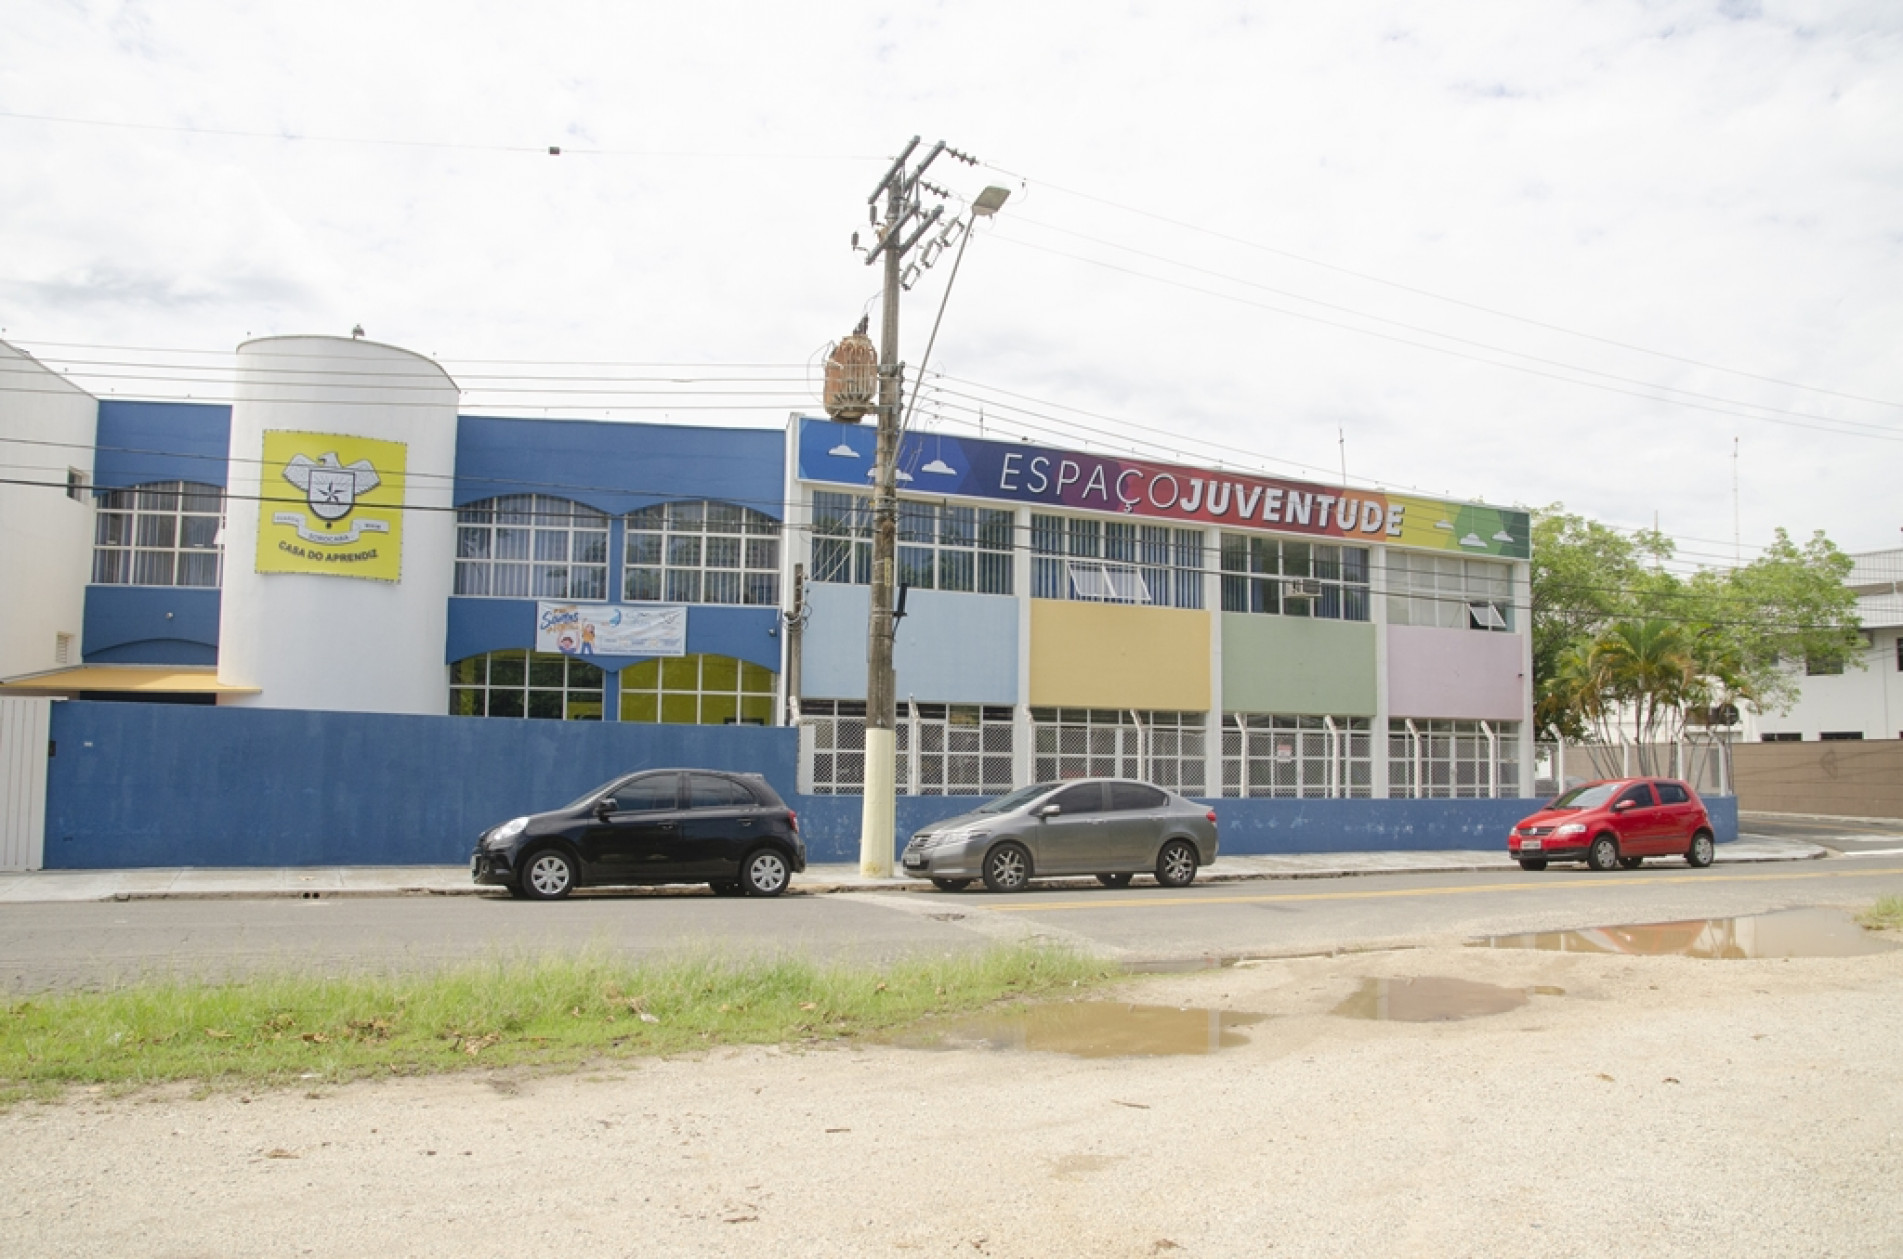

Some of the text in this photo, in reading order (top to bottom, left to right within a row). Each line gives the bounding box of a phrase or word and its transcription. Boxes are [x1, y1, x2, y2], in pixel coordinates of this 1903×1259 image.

[1000, 452, 1405, 536] ESPAÇO JUVENTUDE
[279, 540, 377, 562] CASA DO APRENDIZ
